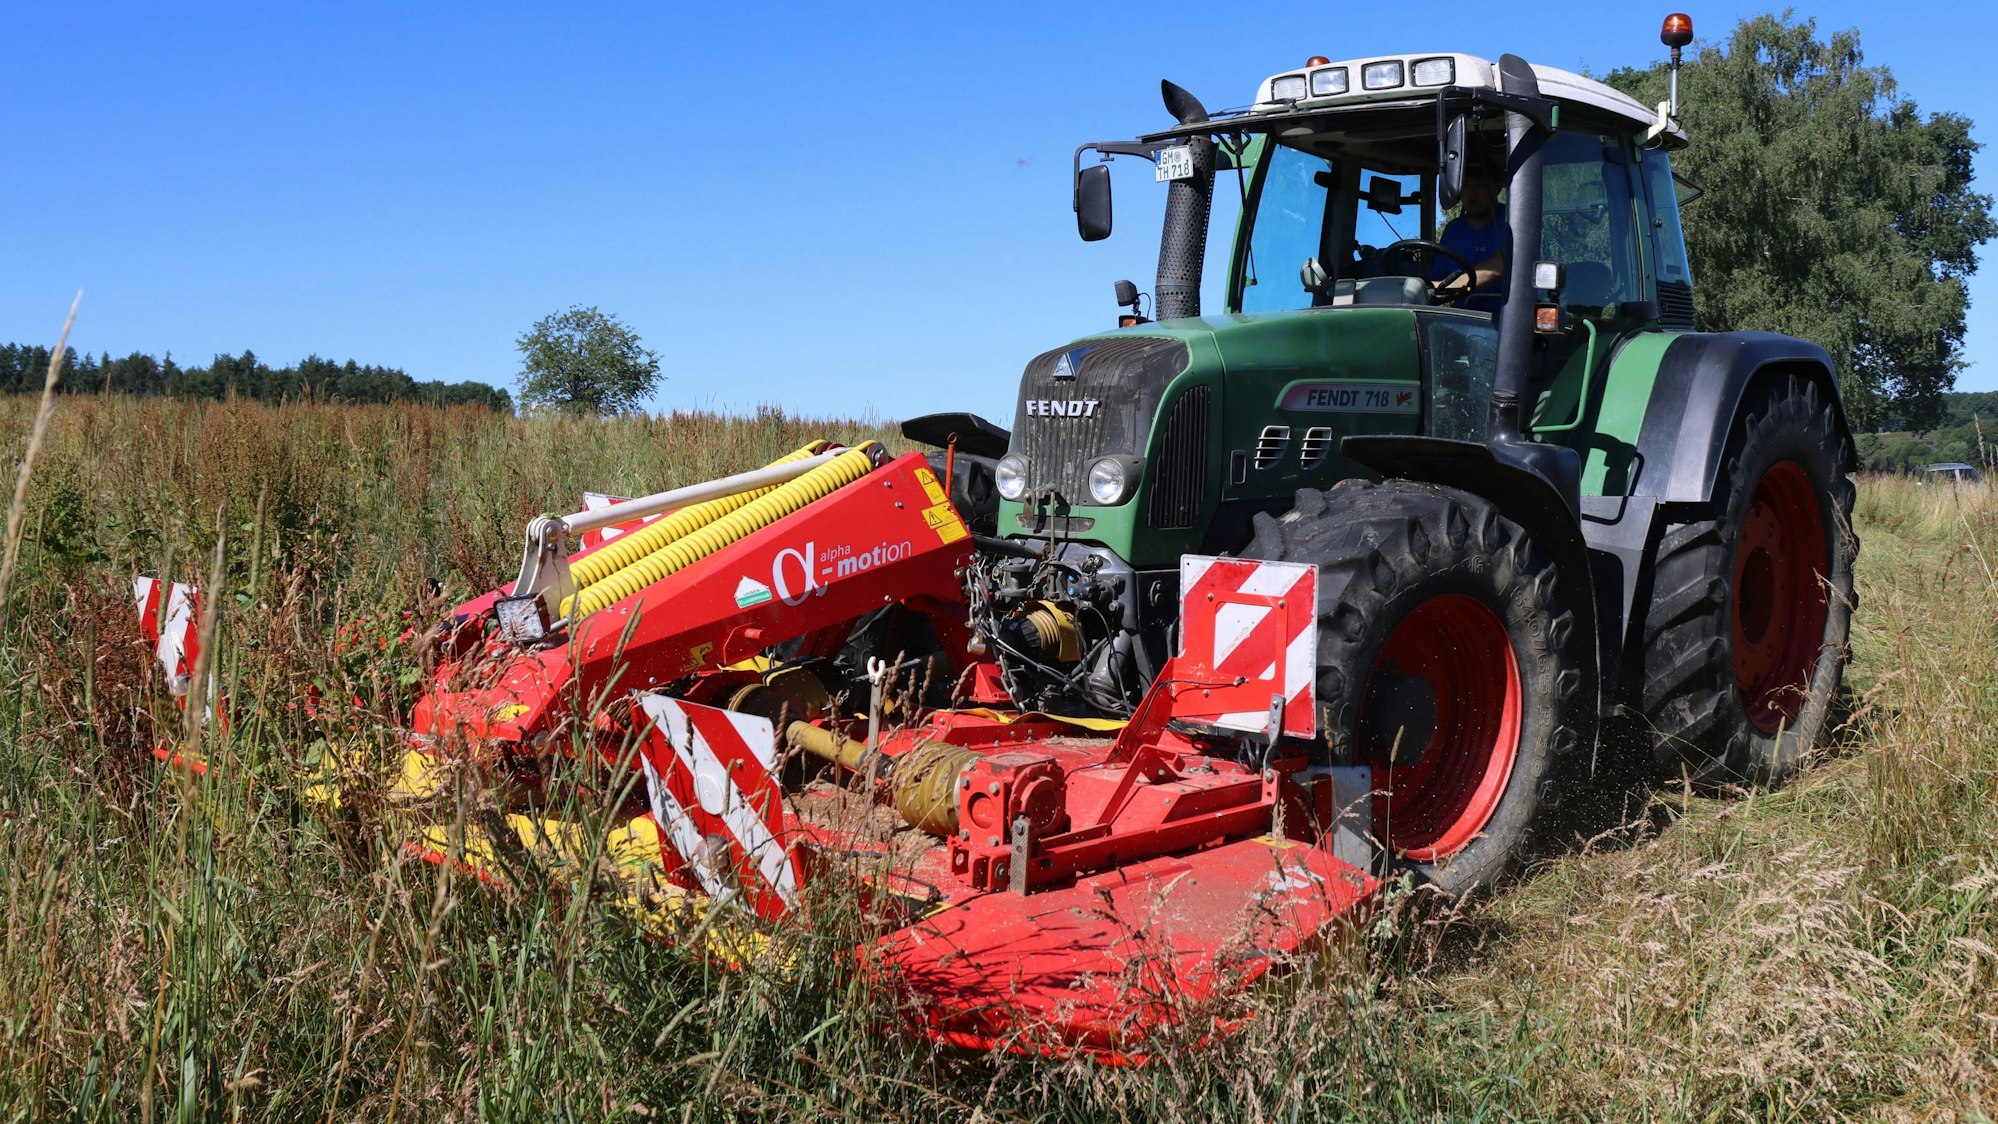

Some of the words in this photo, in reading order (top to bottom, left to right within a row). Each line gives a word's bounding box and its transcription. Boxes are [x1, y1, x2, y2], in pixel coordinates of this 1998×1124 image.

[1162, 151, 1174, 164] GM
[1157, 166, 1169, 179] TH
[1171, 163, 1190, 177] 718
[1306, 389, 1360, 407] FENDT
[1365, 390, 1389, 407] 718
[1025, 399, 1099, 417] FENDT
[820, 545, 851, 562] alpha
[1539, 704, 1553, 727] R
